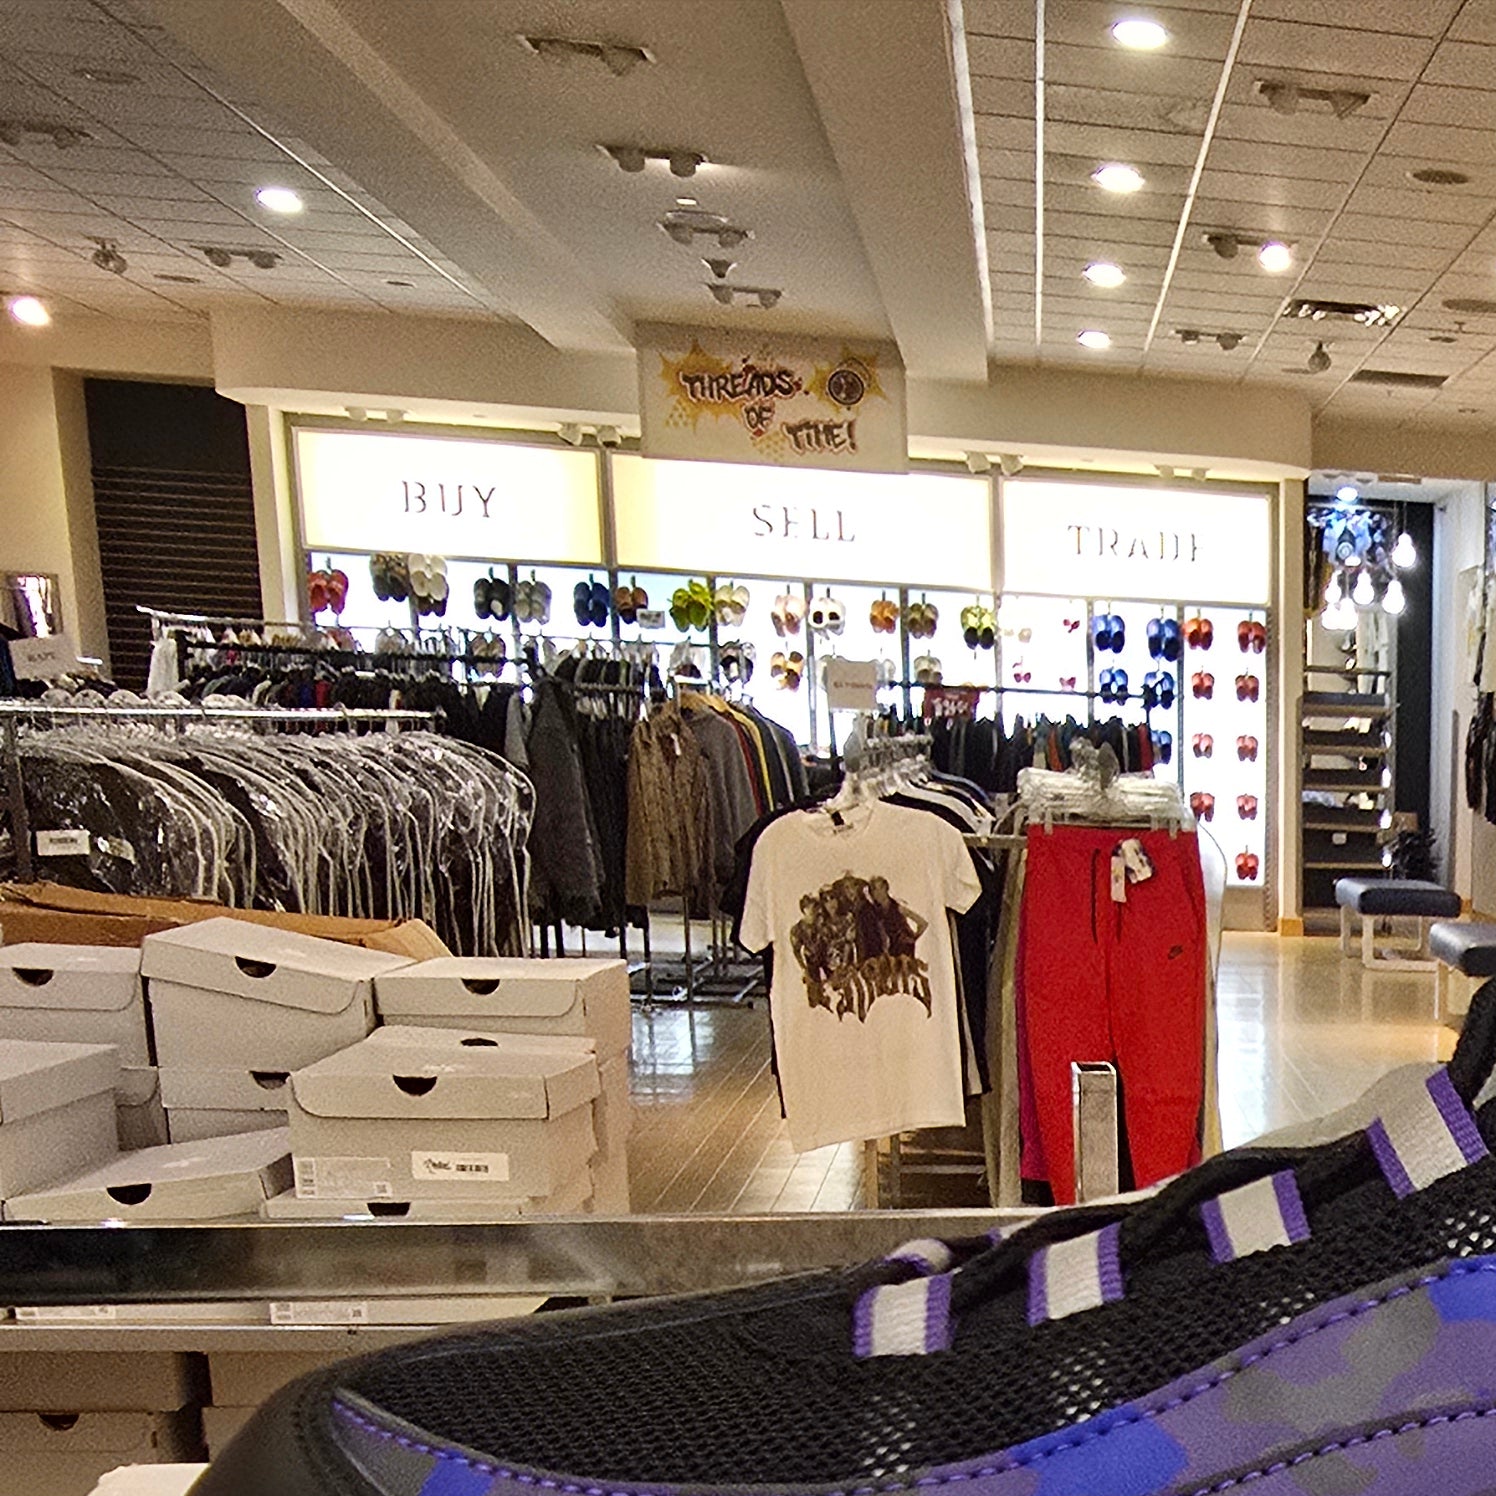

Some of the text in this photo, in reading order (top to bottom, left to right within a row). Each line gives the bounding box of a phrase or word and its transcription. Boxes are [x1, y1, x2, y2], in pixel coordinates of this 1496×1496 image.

[680, 367, 797, 400] THREADS
[744, 404, 774, 431] OF
[401, 480, 496, 518] BUY
[752, 503, 856, 542] SELL
